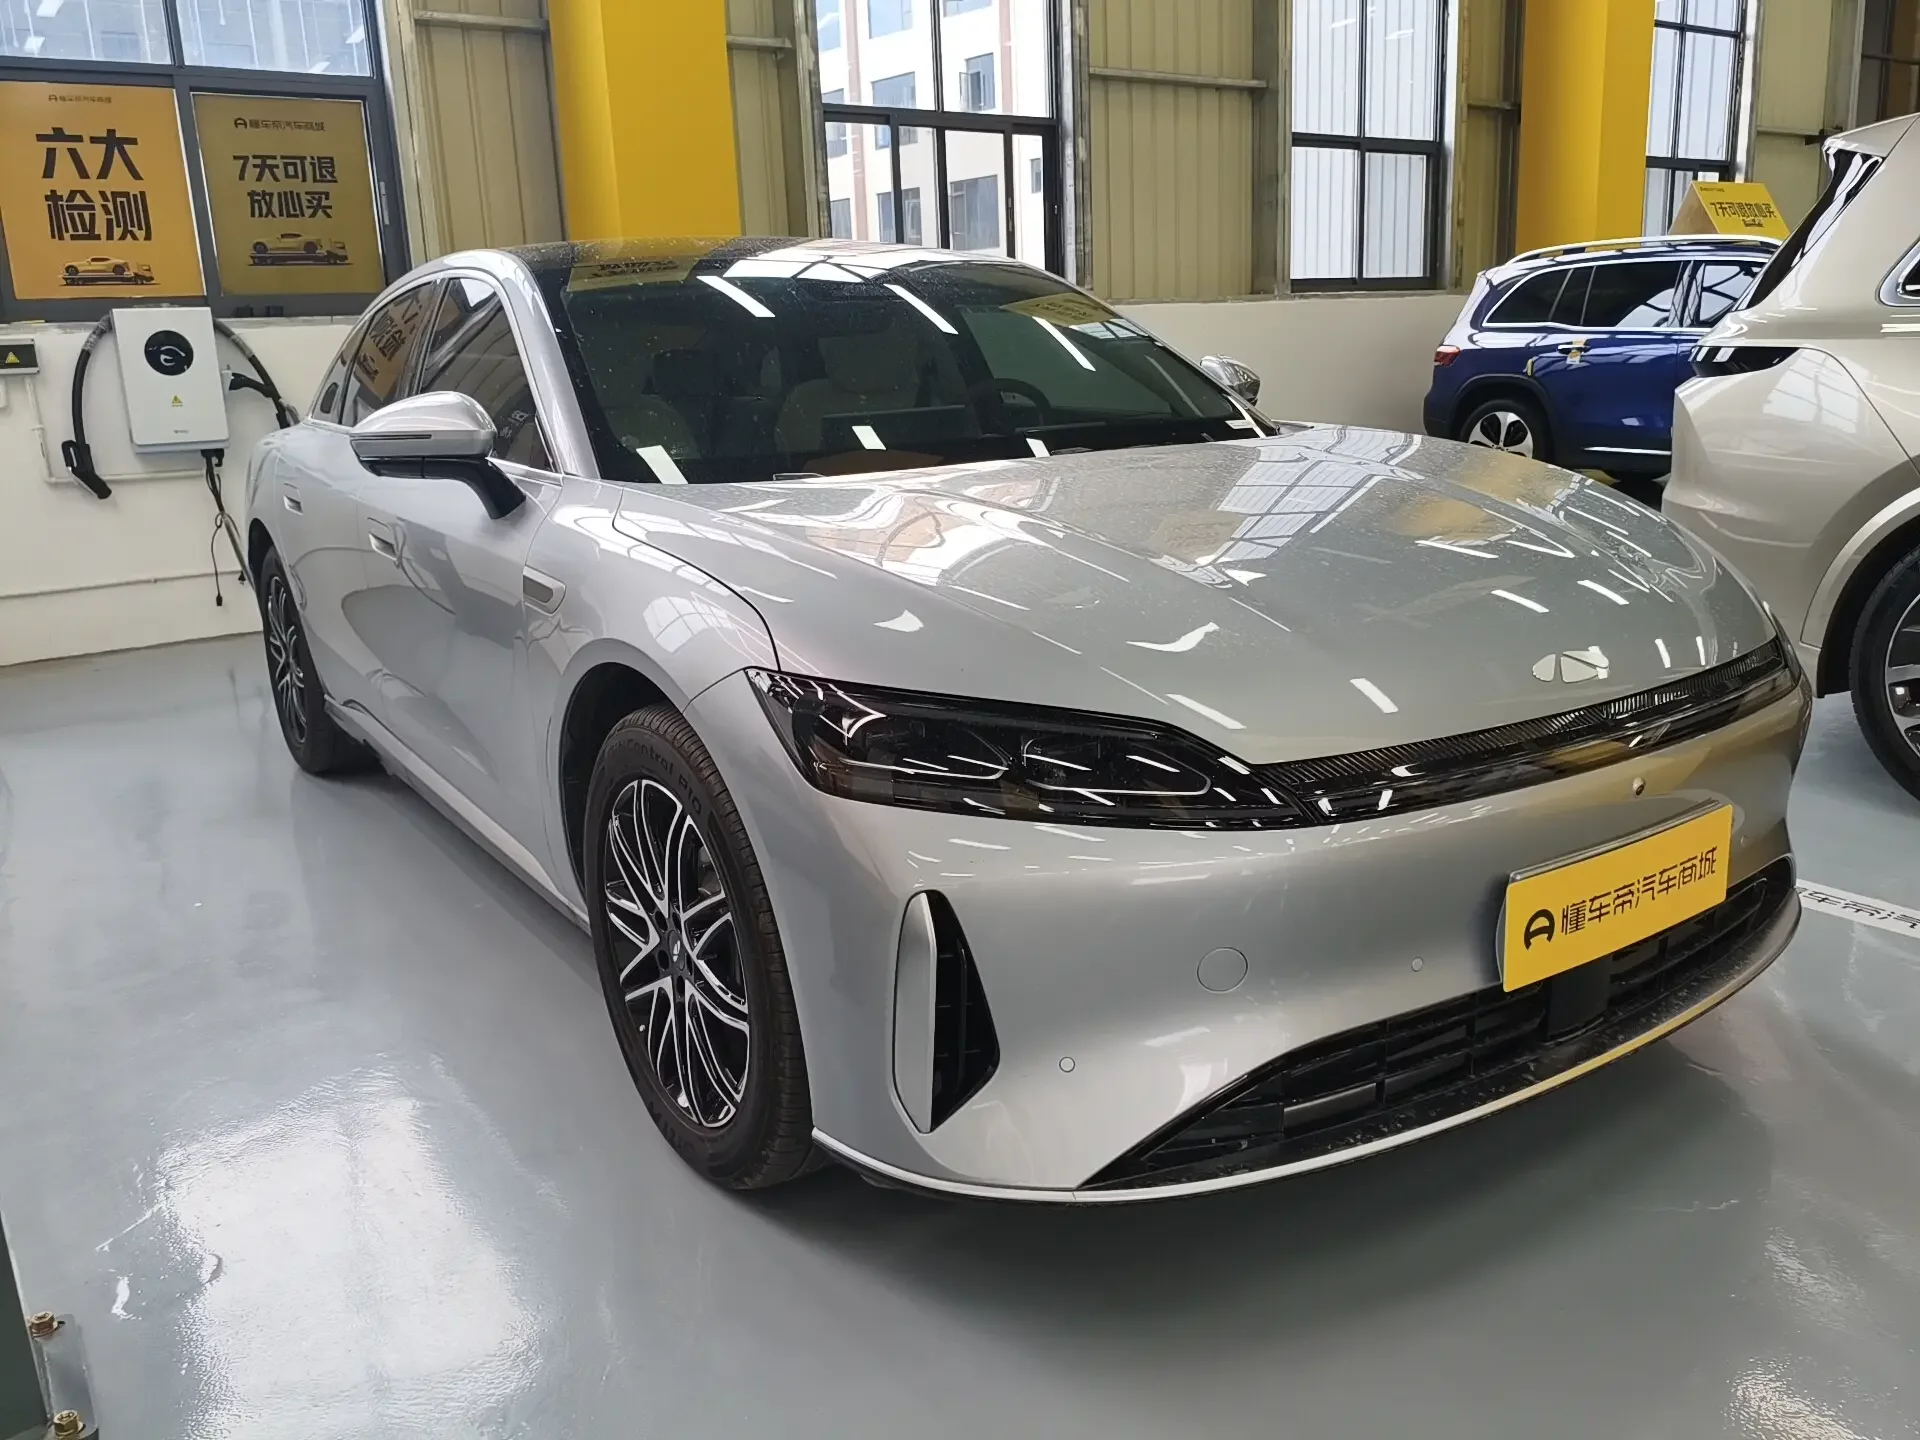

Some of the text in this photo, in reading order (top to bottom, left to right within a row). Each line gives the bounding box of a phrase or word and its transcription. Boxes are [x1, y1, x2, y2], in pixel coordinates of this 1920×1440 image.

[36, 127, 144, 180] 六大
[233, 154, 338, 183] 7天可退
[44, 189, 153, 241] 检测
[248, 190, 332, 219] 放心买
[1561, 846, 1718, 935] 懂车帝汽车商城
